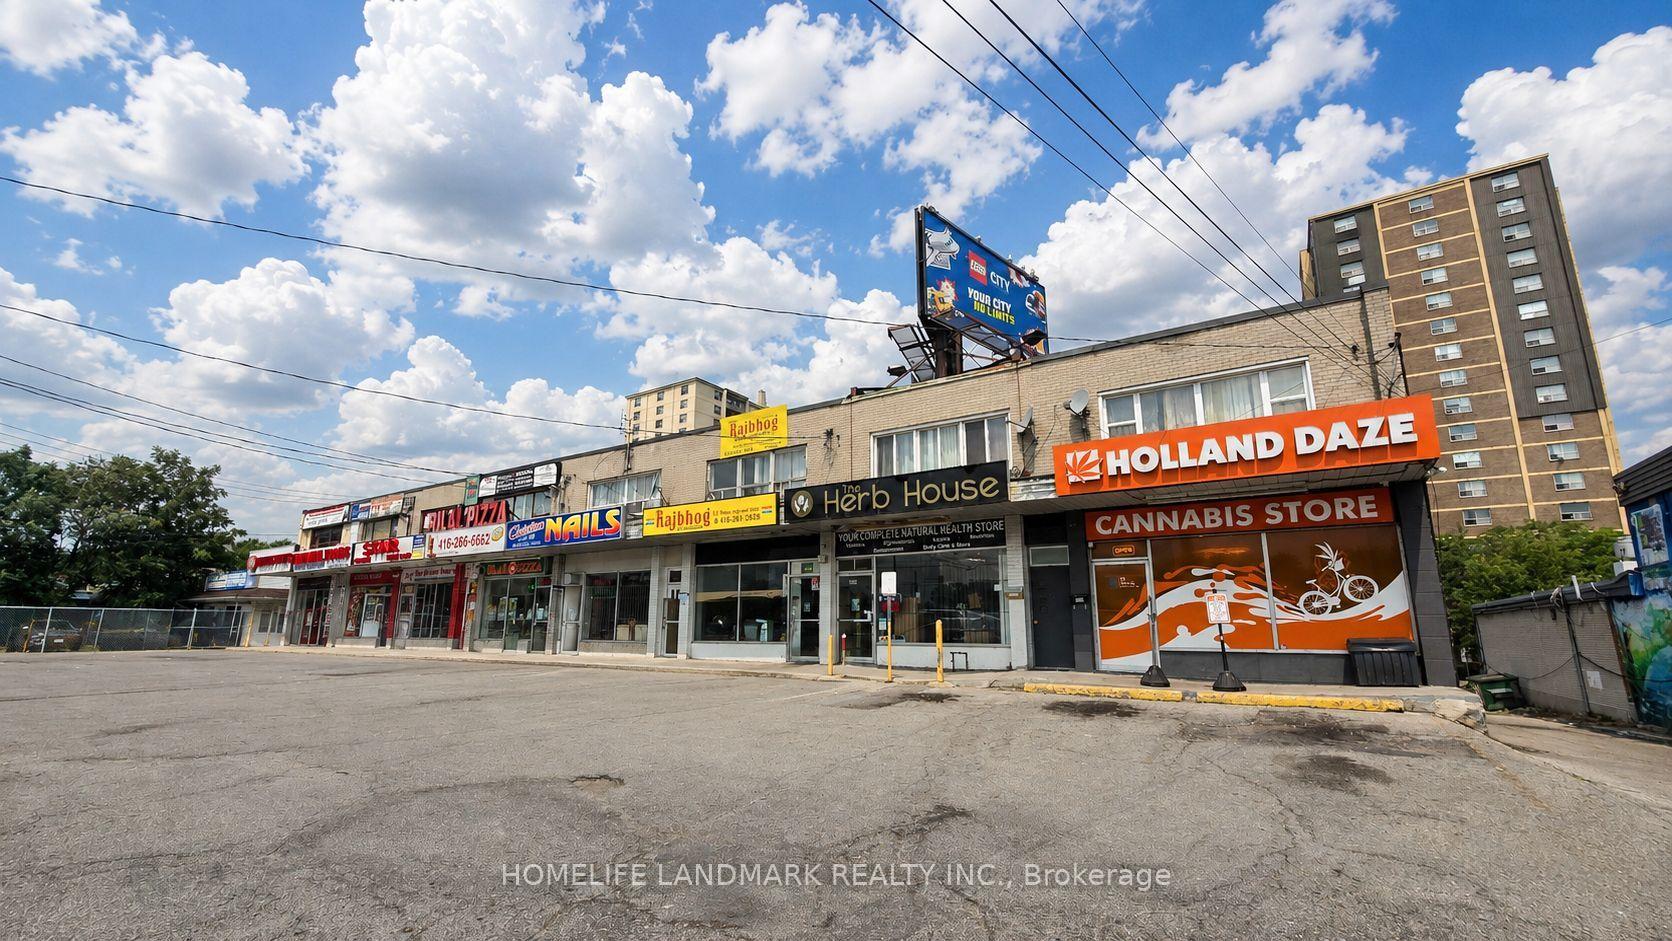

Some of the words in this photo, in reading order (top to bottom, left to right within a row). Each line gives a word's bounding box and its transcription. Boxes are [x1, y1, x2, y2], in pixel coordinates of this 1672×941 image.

[990, 271, 1010, 293] CITY
[968, 287, 991, 306] YOUR
[993, 297, 1012, 313] CITY
[986, 306, 1015, 325] LIMITS
[730, 414, 778, 437] Rajbhog
[1106, 431, 1285, 477] HOLLAND
[1294, 412, 1419, 456] DAZE
[824, 483, 891, 515] Herb
[904, 476, 1000, 507] House
[464, 499, 507, 528] PIZZA
[545, 509, 621, 542] NAILS
[656, 508, 710, 531] Rajbhog
[1094, 504, 1254, 536] CANNABIS
[1265, 494, 1378, 525] STORE
[838, 532, 860, 543] YOUR
[860, 528, 900, 541] COMPLETE
[901, 525, 938, 538] NATURAL
[940, 522, 973, 535] HEALTH
[975, 520, 1004, 533] STORE
